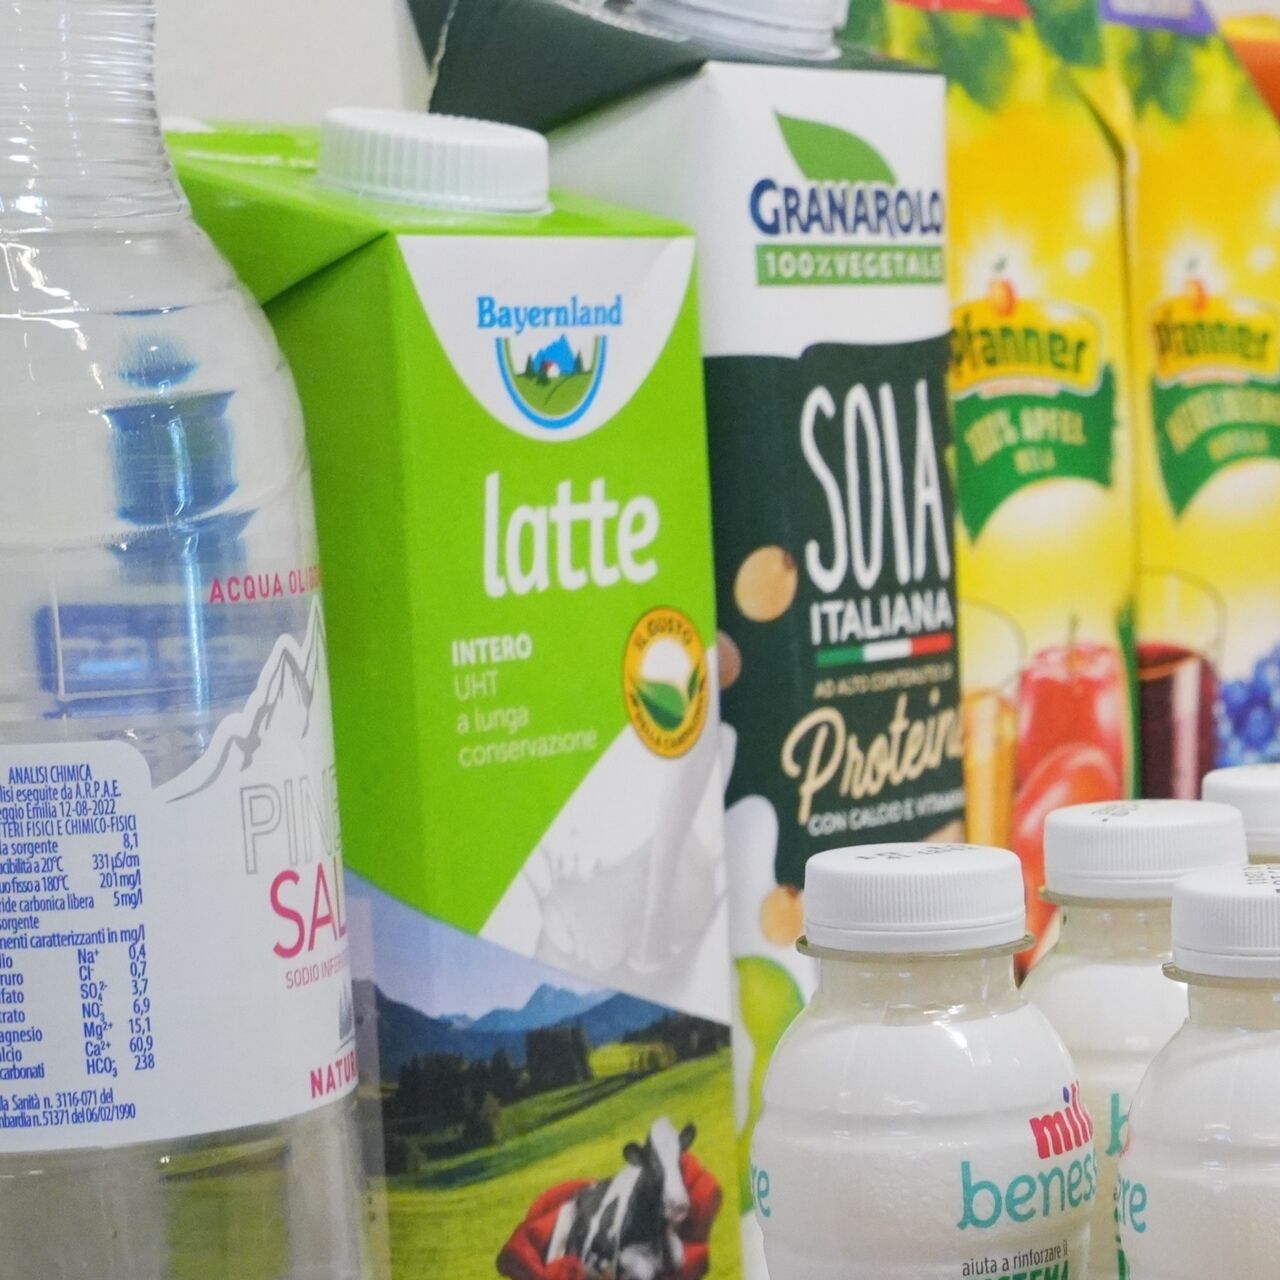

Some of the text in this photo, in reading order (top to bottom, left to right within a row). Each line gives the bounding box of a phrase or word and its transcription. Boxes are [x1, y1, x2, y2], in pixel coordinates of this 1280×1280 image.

[750, 178, 942, 237] GRANAROLO
[477, 295, 622, 335] Bayernland
[801, 379, 950, 593] SOIA
[482, 470, 660, 599] latte
[209, 572, 283, 603] ACQUA
[810, 589, 953, 645] ITALIANA
[452, 633, 533, 667] INTERO
[454, 670, 498, 701] UHT
[457, 706, 530, 735] a lunga
[458, 728, 598, 768] conservazione
[9, 764, 92, 785] ANALISI CHIMICA
[16, 785, 59, 806] eseguite
[60, 784, 73, 800] da
[26, 801, 57, 820] Emilia
[60, 799, 116, 817] 12-08-2022
[26, 819, 54, 837] FISICI
[57, 820, 63, 836] E
[65, 815, 137, 835] CHIMICO-FISICI
[11, 840, 59, 858] sorgente
[123, 833, 139, 851] 8,1
[34, 861, 40, 873] a
[92, 853, 109, 870] 331
[12, 876, 33, 893] fisso
[34, 880, 40, 892] a
[100, 872, 118, 889] 201
[19, 894, 66, 912] carbonica
[67, 893, 95, 910] libera
[114, 891, 120, 907] 5
[30, 928, 105, 948] caratterizzanti
[107, 928, 118, 943] in
[129, 944, 147, 962] 0,4
[130, 961, 147, 978] 0,7
[286, 962, 320, 989] SODIO
[131, 978, 148, 997] 3,7
[133, 997, 151, 1016] 6,9
[129, 1017, 151, 1036] 15,1
[129, 1035, 154, 1054] 60,9
[134, 1053, 156, 1071] 238
[12, 1092, 41, 1112] Sanità
[56, 1090, 97, 1109] 3116-071
[100, 1087, 114, 1104] del
[42, 1109, 70, 1126] 51371
[72, 1107, 85, 1124] del
[1028, 1079, 1093, 1160] mil
[957, 1152, 1097, 1231] benes
[962, 1257, 997, 1277] aiuta
[1002, 1257, 1010, 1272] a
[1013, 1245, 1062, 1270] rinforzare
